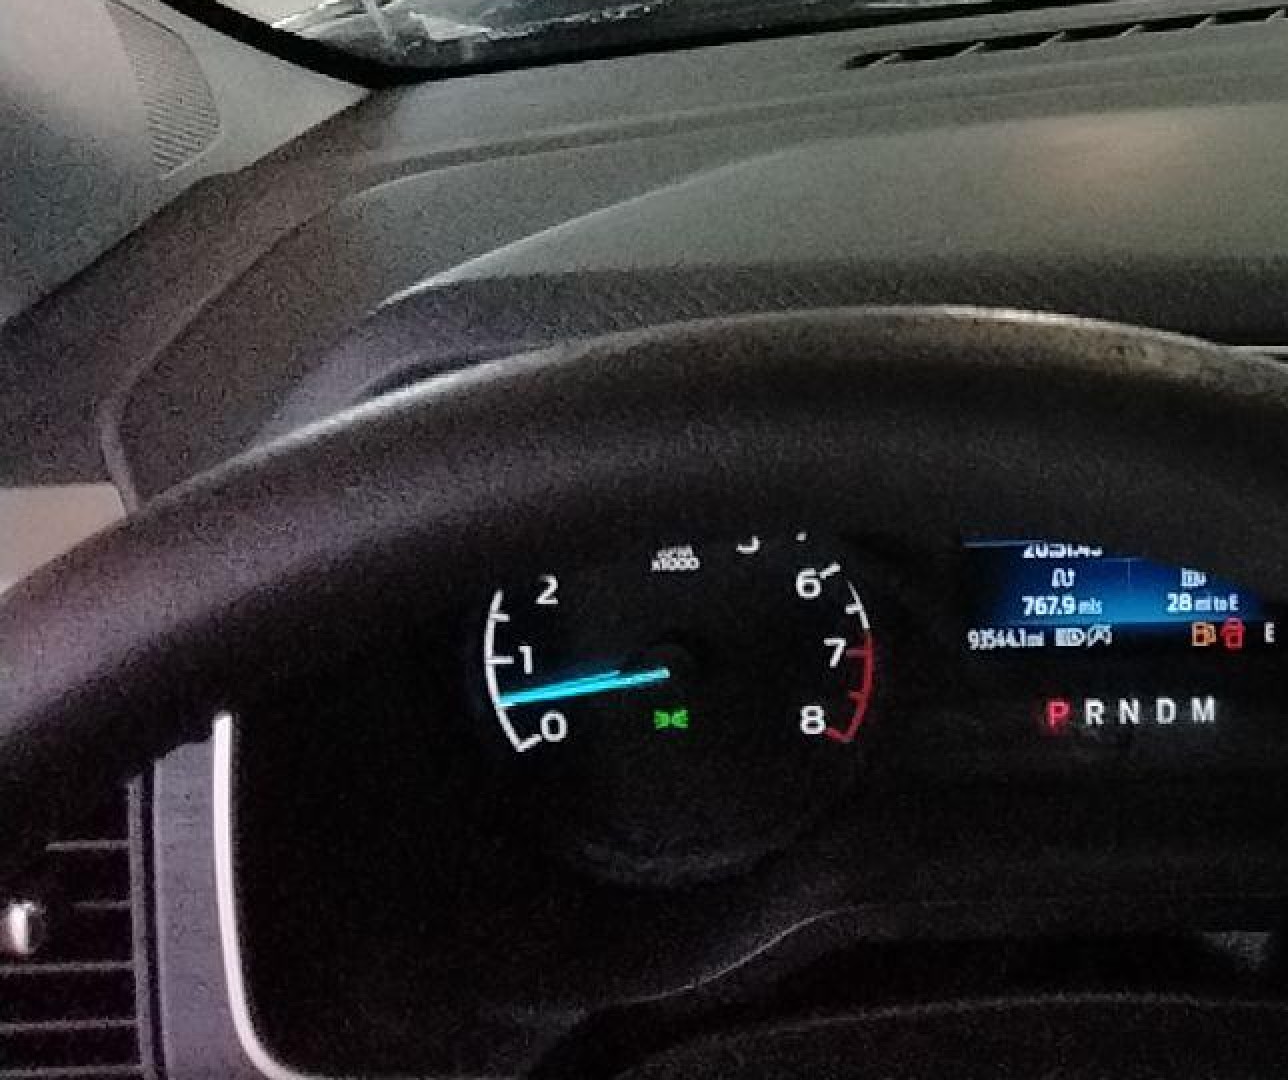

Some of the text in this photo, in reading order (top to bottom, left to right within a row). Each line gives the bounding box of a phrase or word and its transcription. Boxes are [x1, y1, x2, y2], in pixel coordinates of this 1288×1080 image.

[536, 574, 560, 606] 2
[796, 568, 822, 600] 6
[1021, 595, 1076, 617] 767.9
[1166, 592, 1192, 612] 28
[1264, 621, 1276, 644] E
[518, 645, 533, 675] 1
[823, 637, 847, 667] 7
[540, 710, 568, 741] 0
[799, 705, 826, 735] 8
[1047, 696, 1215, 727] P R N D M
